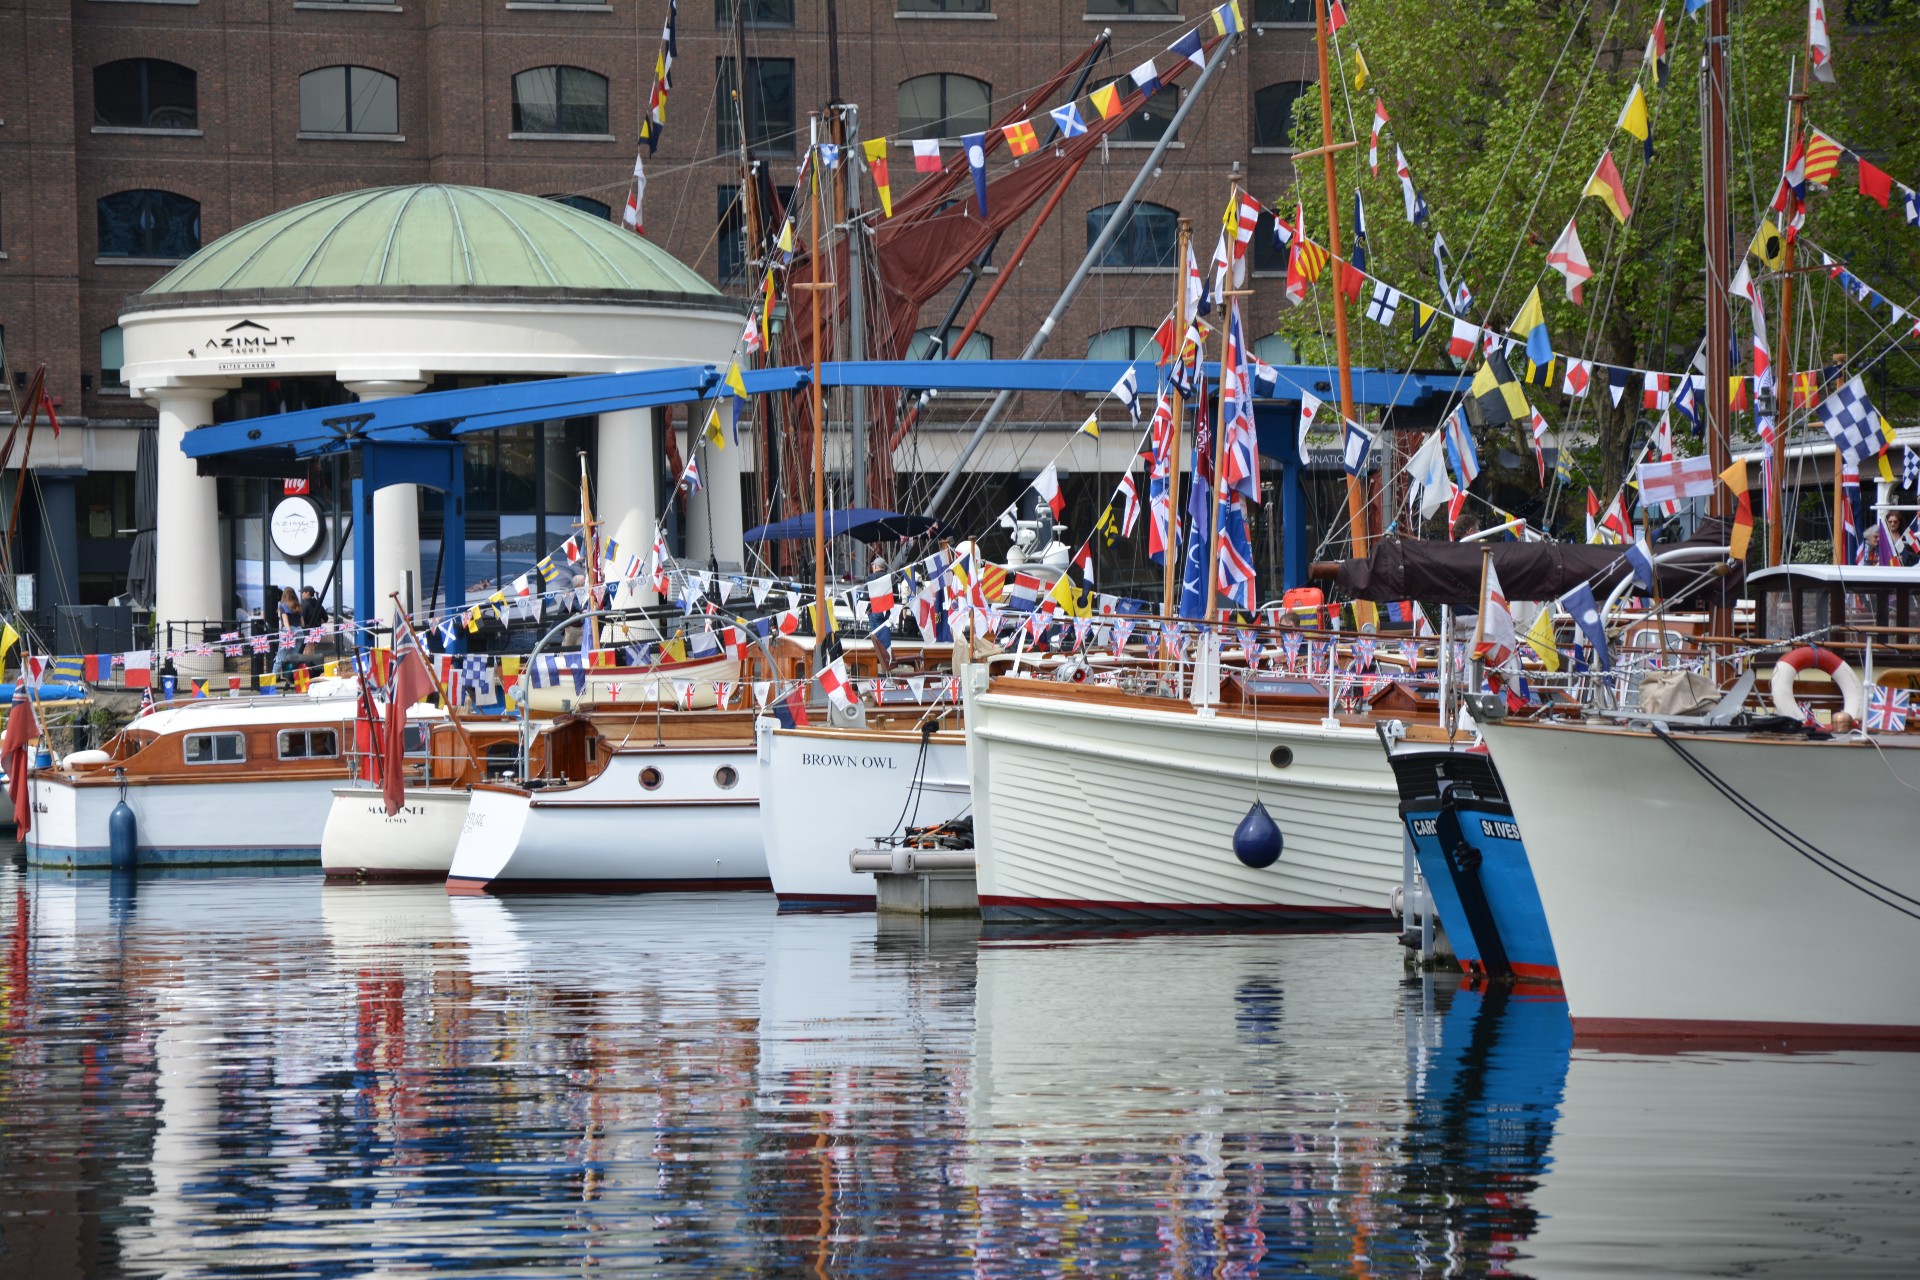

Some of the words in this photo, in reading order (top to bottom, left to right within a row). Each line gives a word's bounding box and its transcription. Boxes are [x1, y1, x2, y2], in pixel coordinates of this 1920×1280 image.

[205, 336, 295, 349] AZIMUT
[1308, 453, 1345, 464] RNATIO
[802, 753, 857, 767] BROWN
[861, 756, 897, 769] OWL
[1481, 820, 1496, 836] St
[1494, 821, 1521, 840] IVES
